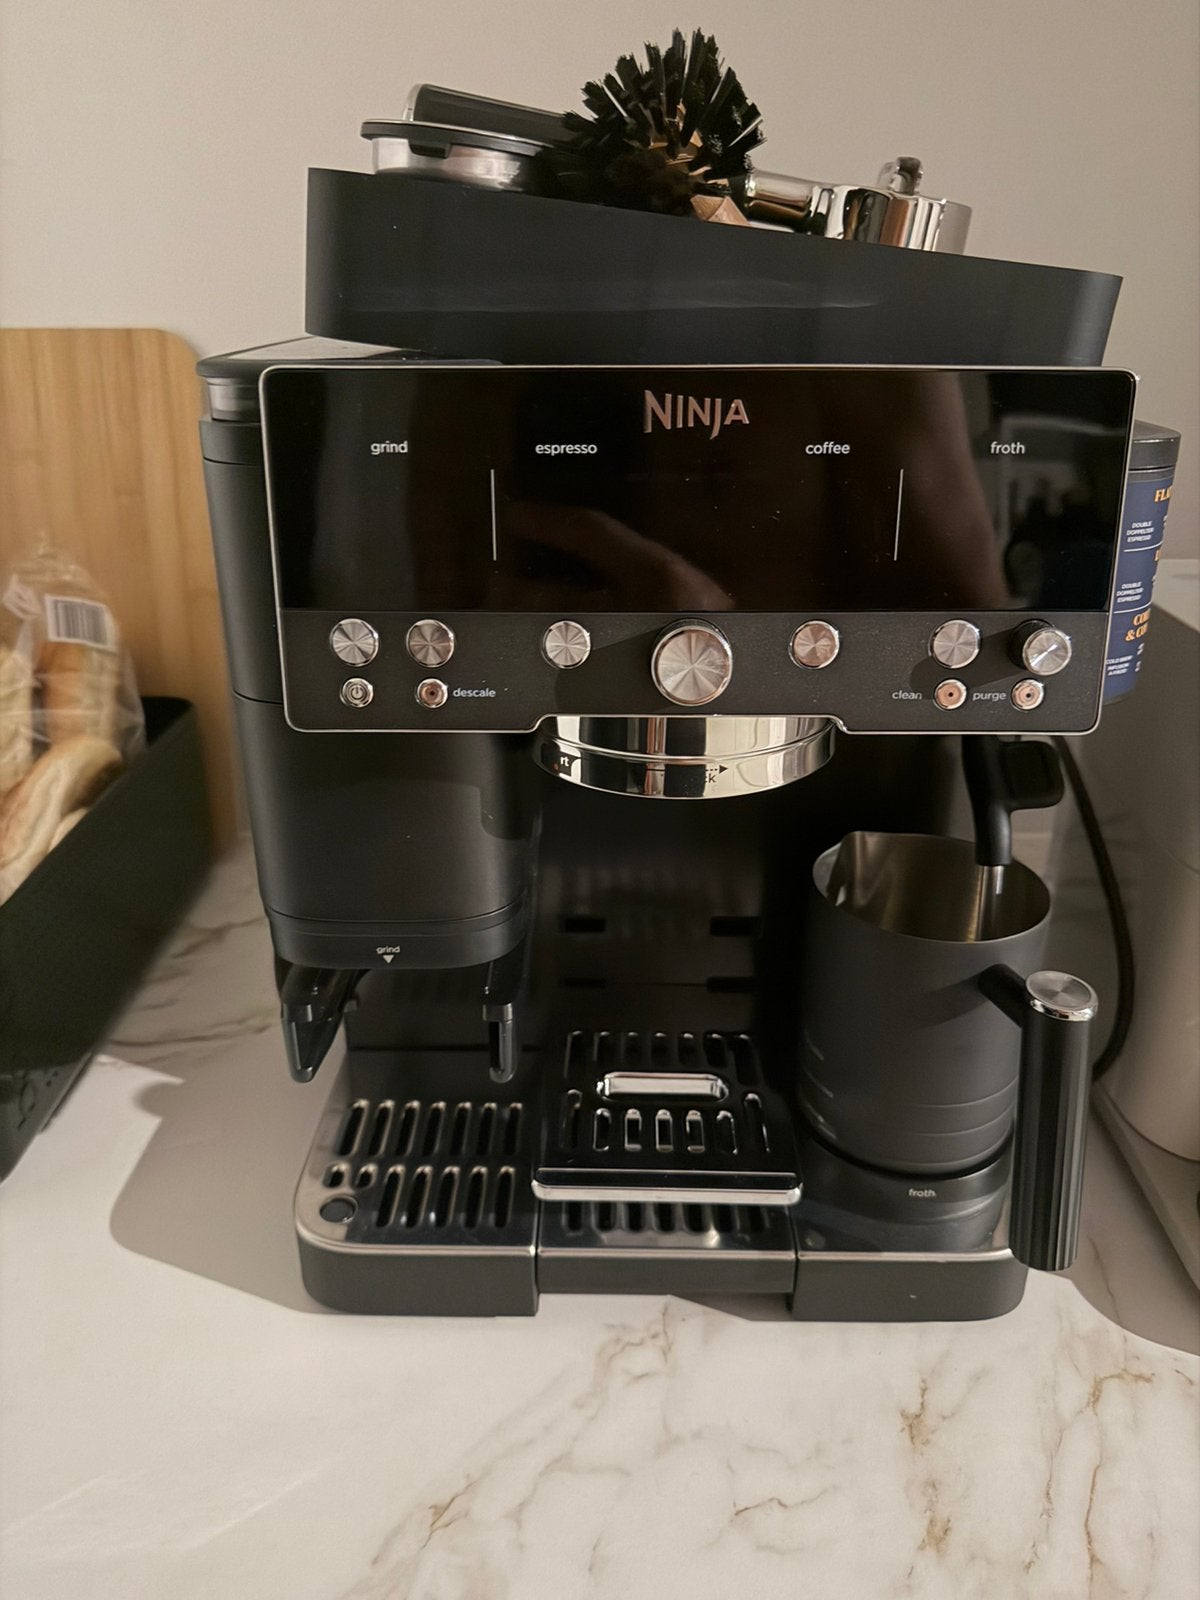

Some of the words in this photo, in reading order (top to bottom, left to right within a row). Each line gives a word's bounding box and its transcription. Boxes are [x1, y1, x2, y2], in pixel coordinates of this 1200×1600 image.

[644, 390, 750, 439] NINJA
[370, 440, 409, 456] grind
[535, 443, 598, 456] espresso
[805, 441, 850, 455] coffee
[990, 441, 1025, 455] froth
[453, 688, 496, 697] descale
[892, 691, 922, 700] clean
[972, 692, 1007, 702] purge
[376, 945, 400, 954] grind
[908, 1188, 936, 1197] froth
